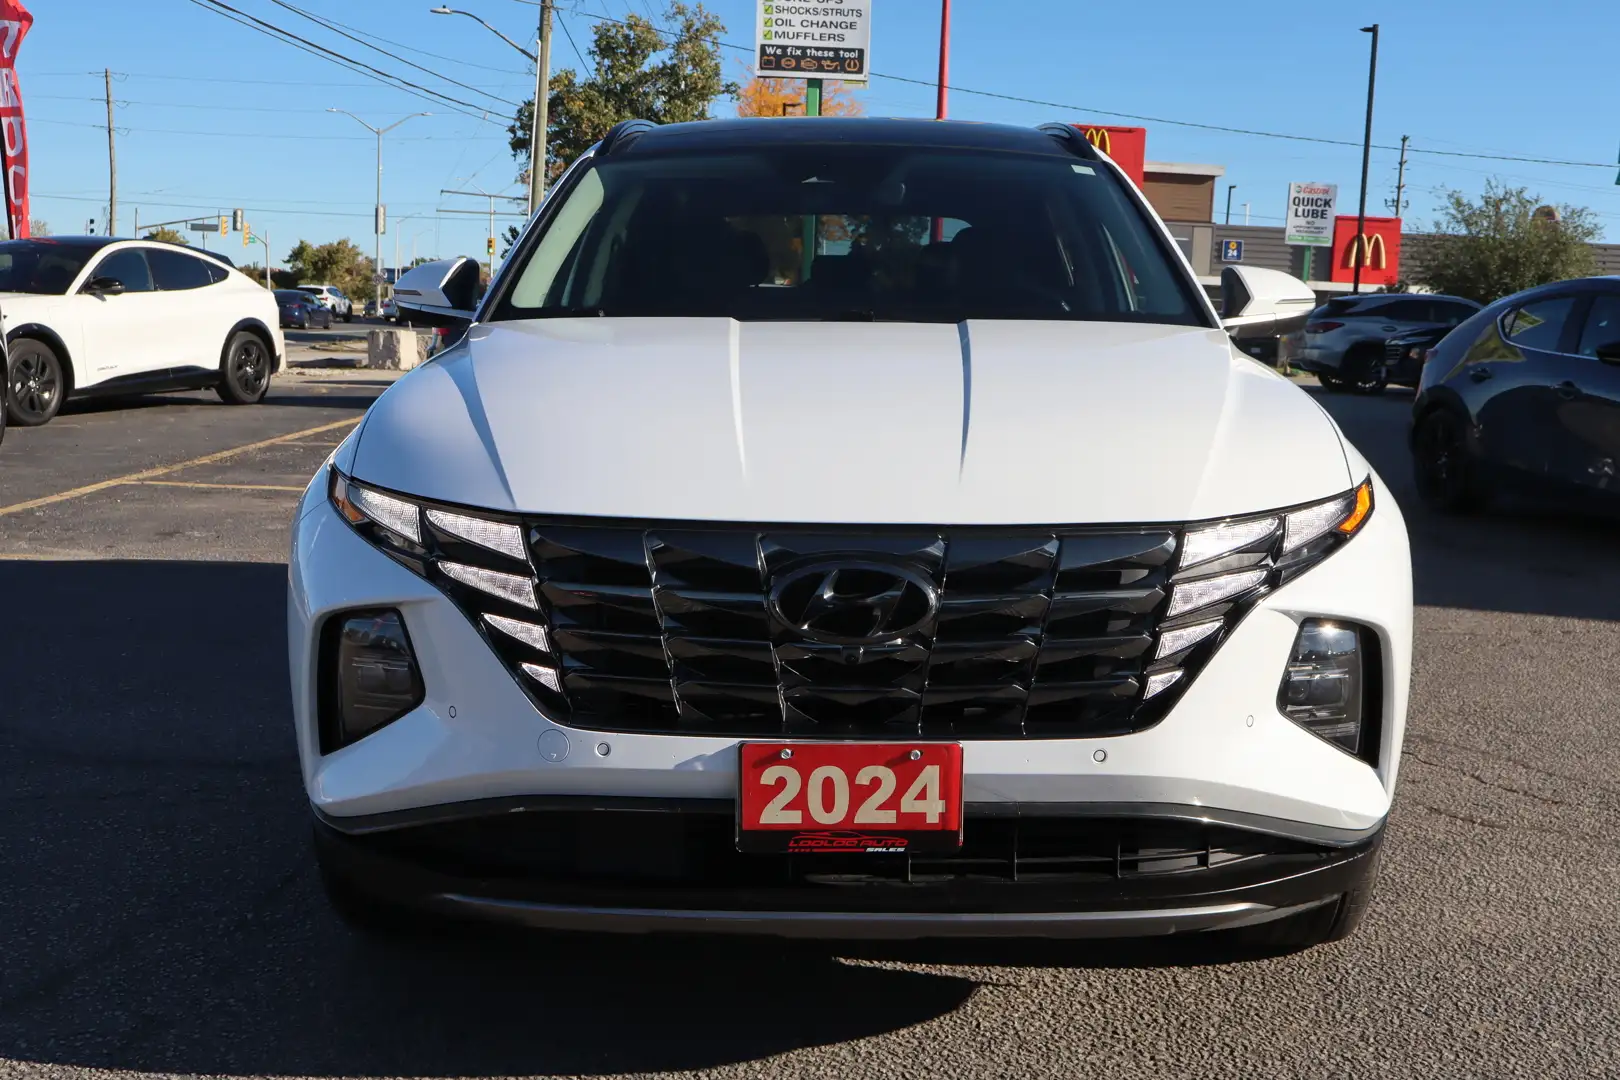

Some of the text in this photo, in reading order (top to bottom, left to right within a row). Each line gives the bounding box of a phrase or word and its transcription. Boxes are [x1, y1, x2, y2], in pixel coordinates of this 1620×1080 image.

[774, 5, 863, 18] SHOCKS/STRUTS
[774, 18, 858, 30] OIL CHANGE
[774, 31, 845, 42] MUFFLERS
[765, 46, 858, 59] We fix these tool
[1292, 196, 1333, 209] QUICK
[1294, 208, 1328, 220] LUBE
[1227, 249, 1238, 257] 24
[759, 764, 946, 825] 2024
[860, 839, 909, 847] AUTO
